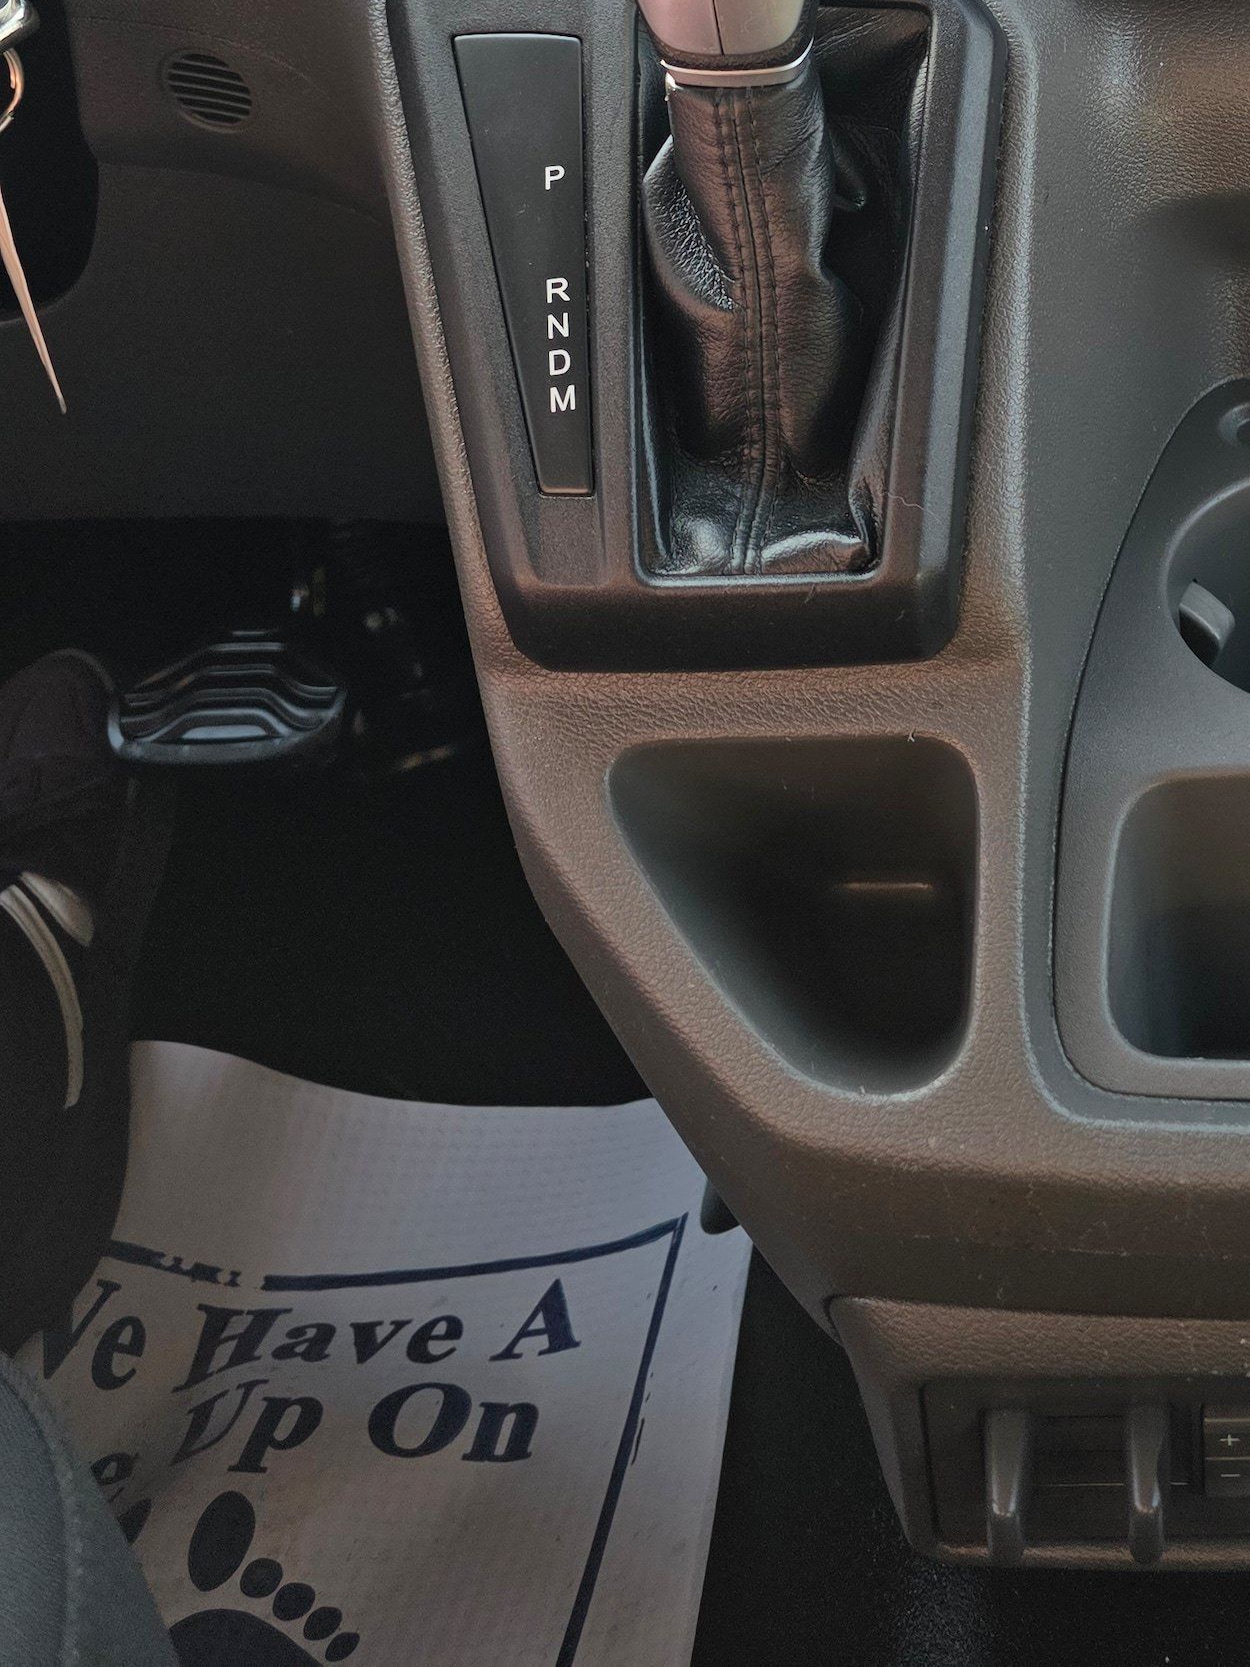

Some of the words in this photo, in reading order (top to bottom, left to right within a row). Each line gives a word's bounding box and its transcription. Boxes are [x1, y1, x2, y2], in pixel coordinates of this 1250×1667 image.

[544, 165, 566, 191] P
[545, 277, 571, 304] R
[546, 312, 571, 340] N
[548, 349, 572, 377] D
[549, 384, 577, 414] M
[171, 1302, 465, 1394] Have
[488, 1277, 583, 1362] A
[169, 1377, 325, 1474] Up
[366, 1381, 540, 1463] On
